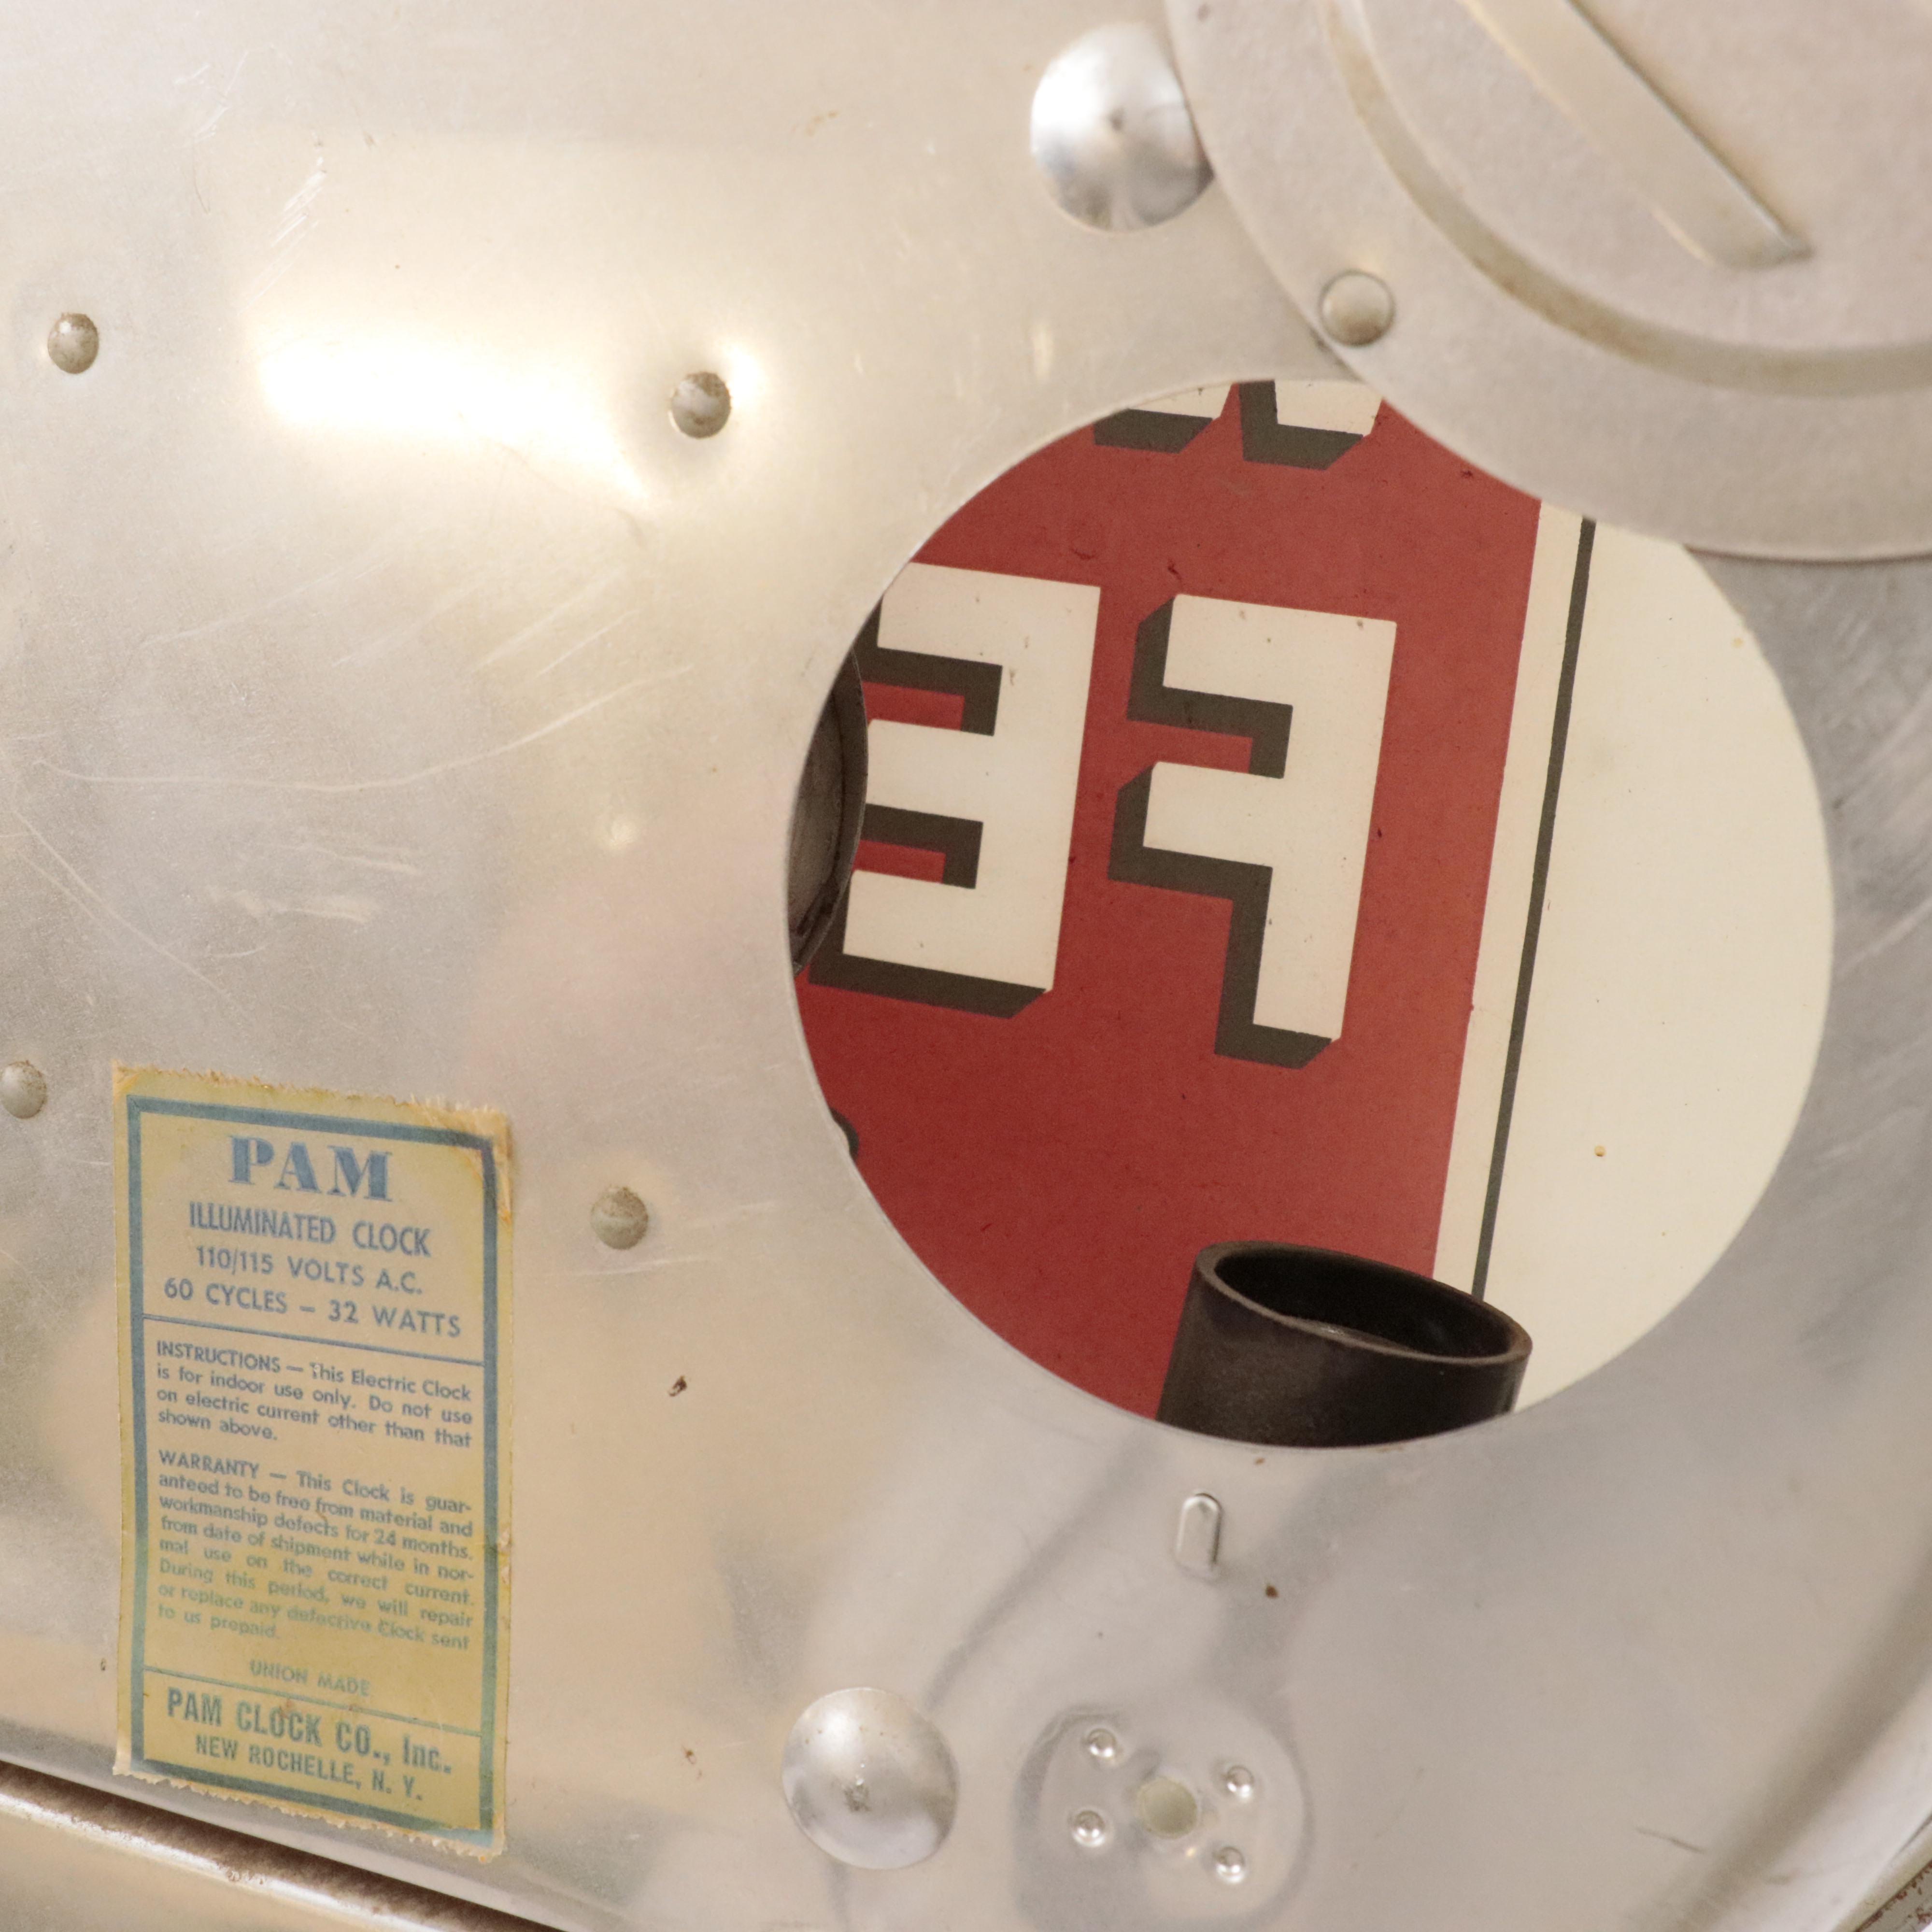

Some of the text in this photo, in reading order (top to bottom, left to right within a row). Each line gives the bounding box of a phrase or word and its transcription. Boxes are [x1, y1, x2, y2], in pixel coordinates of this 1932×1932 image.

[228, 1137, 392, 1202] PAM
[189, 1201, 430, 1256] ILLUMINATED CLOCK
[196, 1245, 423, 1294] 110/115 VOLTS A.C.
[164, 1277, 194, 1300] 60
[205, 1282, 287, 1314] CYCLES
[328, 1299, 358, 1324] 32
[371, 1305, 461, 1338] WATTS
[156, 1340, 281, 1373] INSTRUCTIONS
[309, 1362, 344, 1383] This
[351, 1368, 416, 1393] Electric
[422, 1379, 470, 1401] Clock
[156, 1362, 473, 1425] is for indoor use only. Do not use
[156, 1389, 472, 1448] on electric current other than that
[158, 1408, 277, 1440] shown above.
[158, 1449, 259, 1478] WARRANTY
[296, 1470, 331, 1491] This
[341, 1478, 389, 1502] Clock
[400, 1486, 414, 1506] is
[425, 1496, 471, 1516] guar-
[158, 1474, 473, 1537] anteed to be free from material and
[158, 1495, 472, 1560] workmanship defects for 24 months.
[160, 1515, 474, 1581] from date of shipment while in nor-
[159, 1538, 474, 1605] mal use on the correct current.
[159, 1557, 213, 1584] During
[225, 1570, 256, 1590] this
[341, 1593, 367, 1609] we
[377, 1598, 408, 1617] will
[419, 1608, 473, 1630] repair
[157, 1603, 176, 1619] to
[184, 1611, 201, 1624] us
[158, 1583, 175, 1598] or
[180, 1586, 244, 1609] replace
[249, 1600, 281, 1619] any
[377, 1618, 425, 1643] Clock
[431, 1633, 469, 1650] sent
[249, 1659, 369, 1696] UNION MADE
[167, 1687, 452, 1774] PAM CLOCK CO., Inc.
[196, 1734, 423, 1801] NEW ROCHELLE, N. Y.
